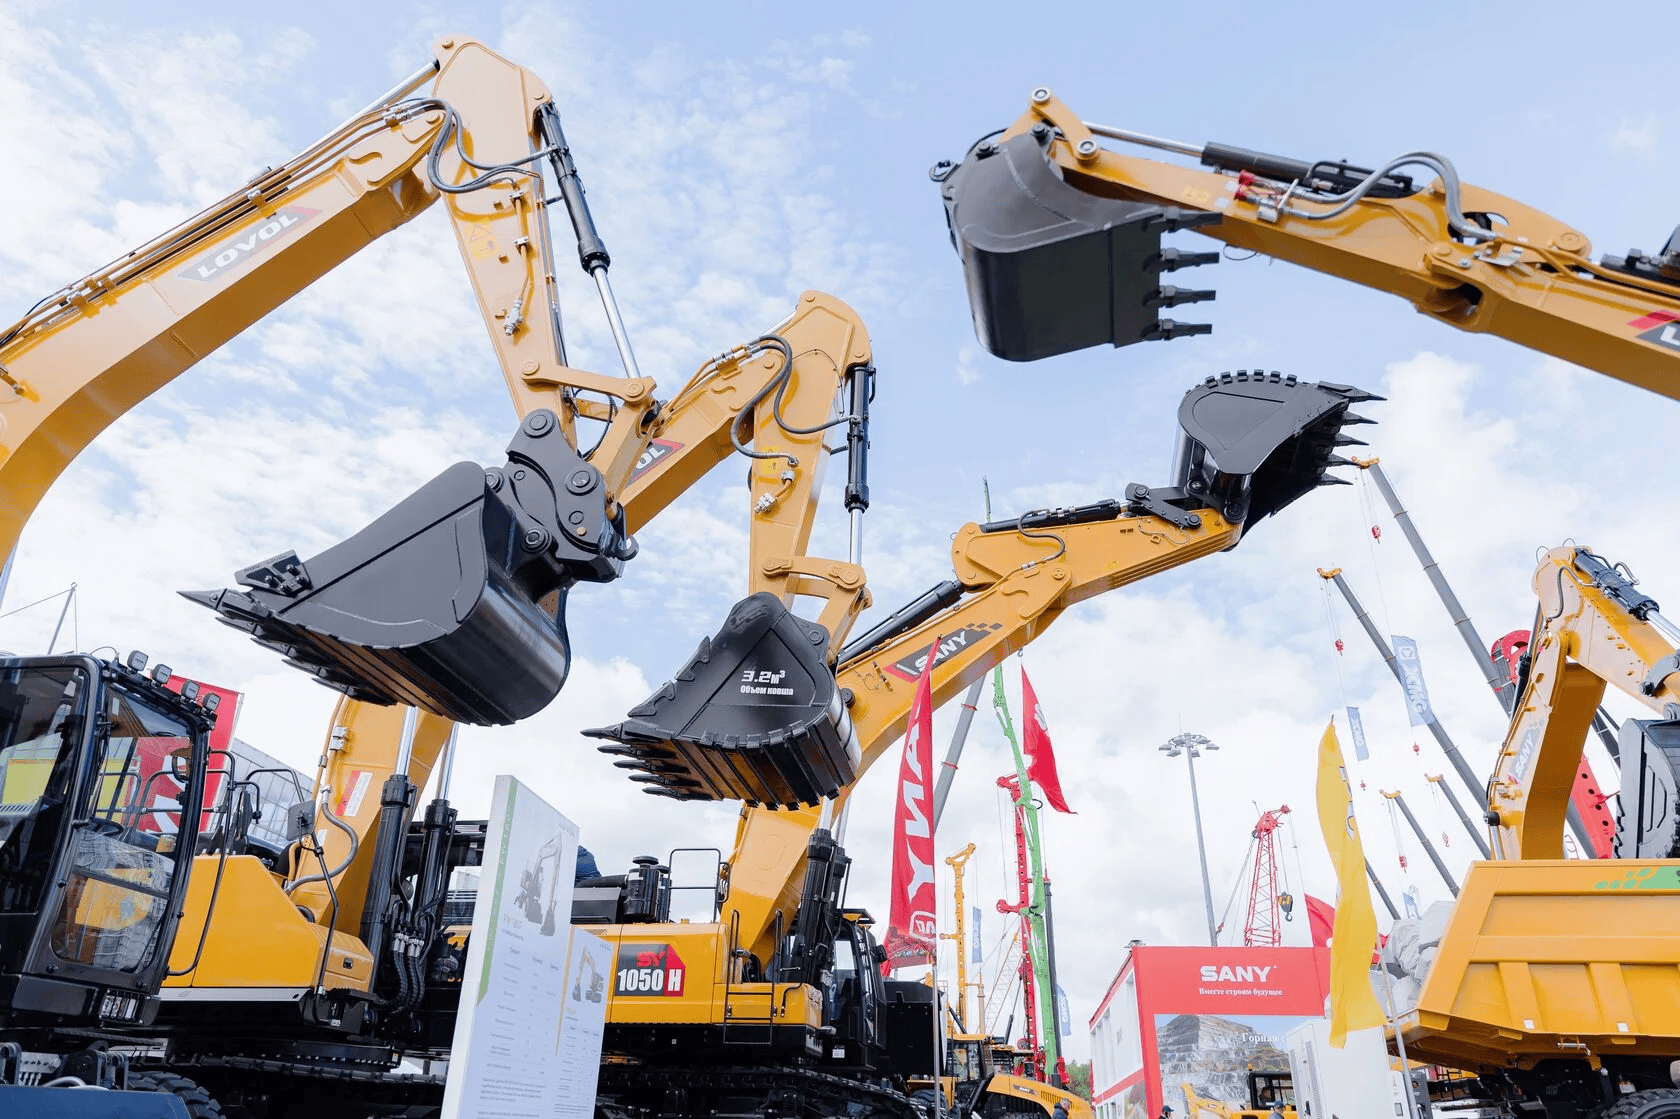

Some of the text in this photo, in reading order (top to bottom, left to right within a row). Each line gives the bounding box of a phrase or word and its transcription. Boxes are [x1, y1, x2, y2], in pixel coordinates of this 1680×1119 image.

[197, 215, 299, 278] LOVOL
[740, 685, 794, 696] Объем ковша
[1200, 965, 1271, 983] SANY
[1199, 987, 1225, 996] Вместе
[1225, 988, 1252, 996] строим
